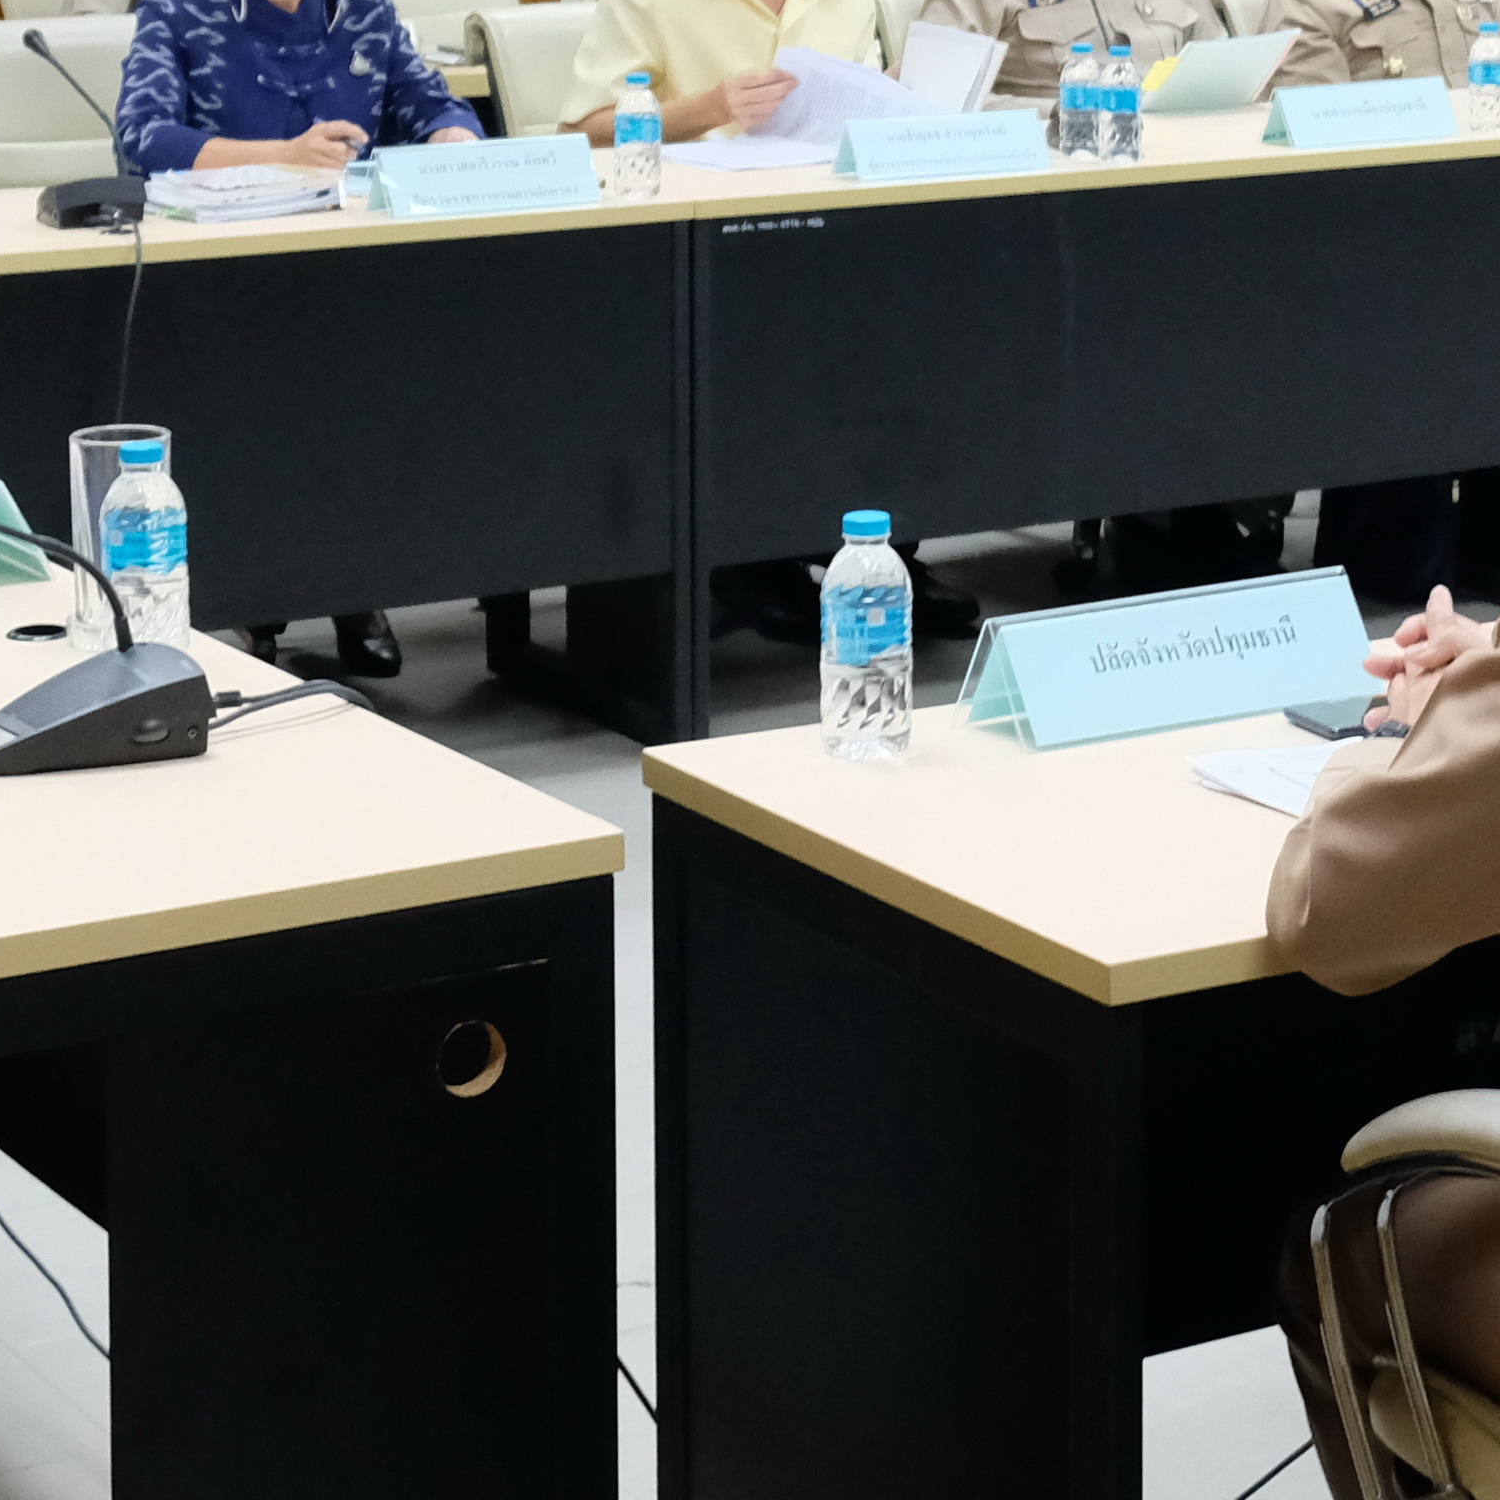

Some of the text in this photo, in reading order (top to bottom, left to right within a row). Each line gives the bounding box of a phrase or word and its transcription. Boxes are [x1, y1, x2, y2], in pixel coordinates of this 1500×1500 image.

[1088, 614, 1297, 675] ปลัดจังหวัดปทุมธานี
